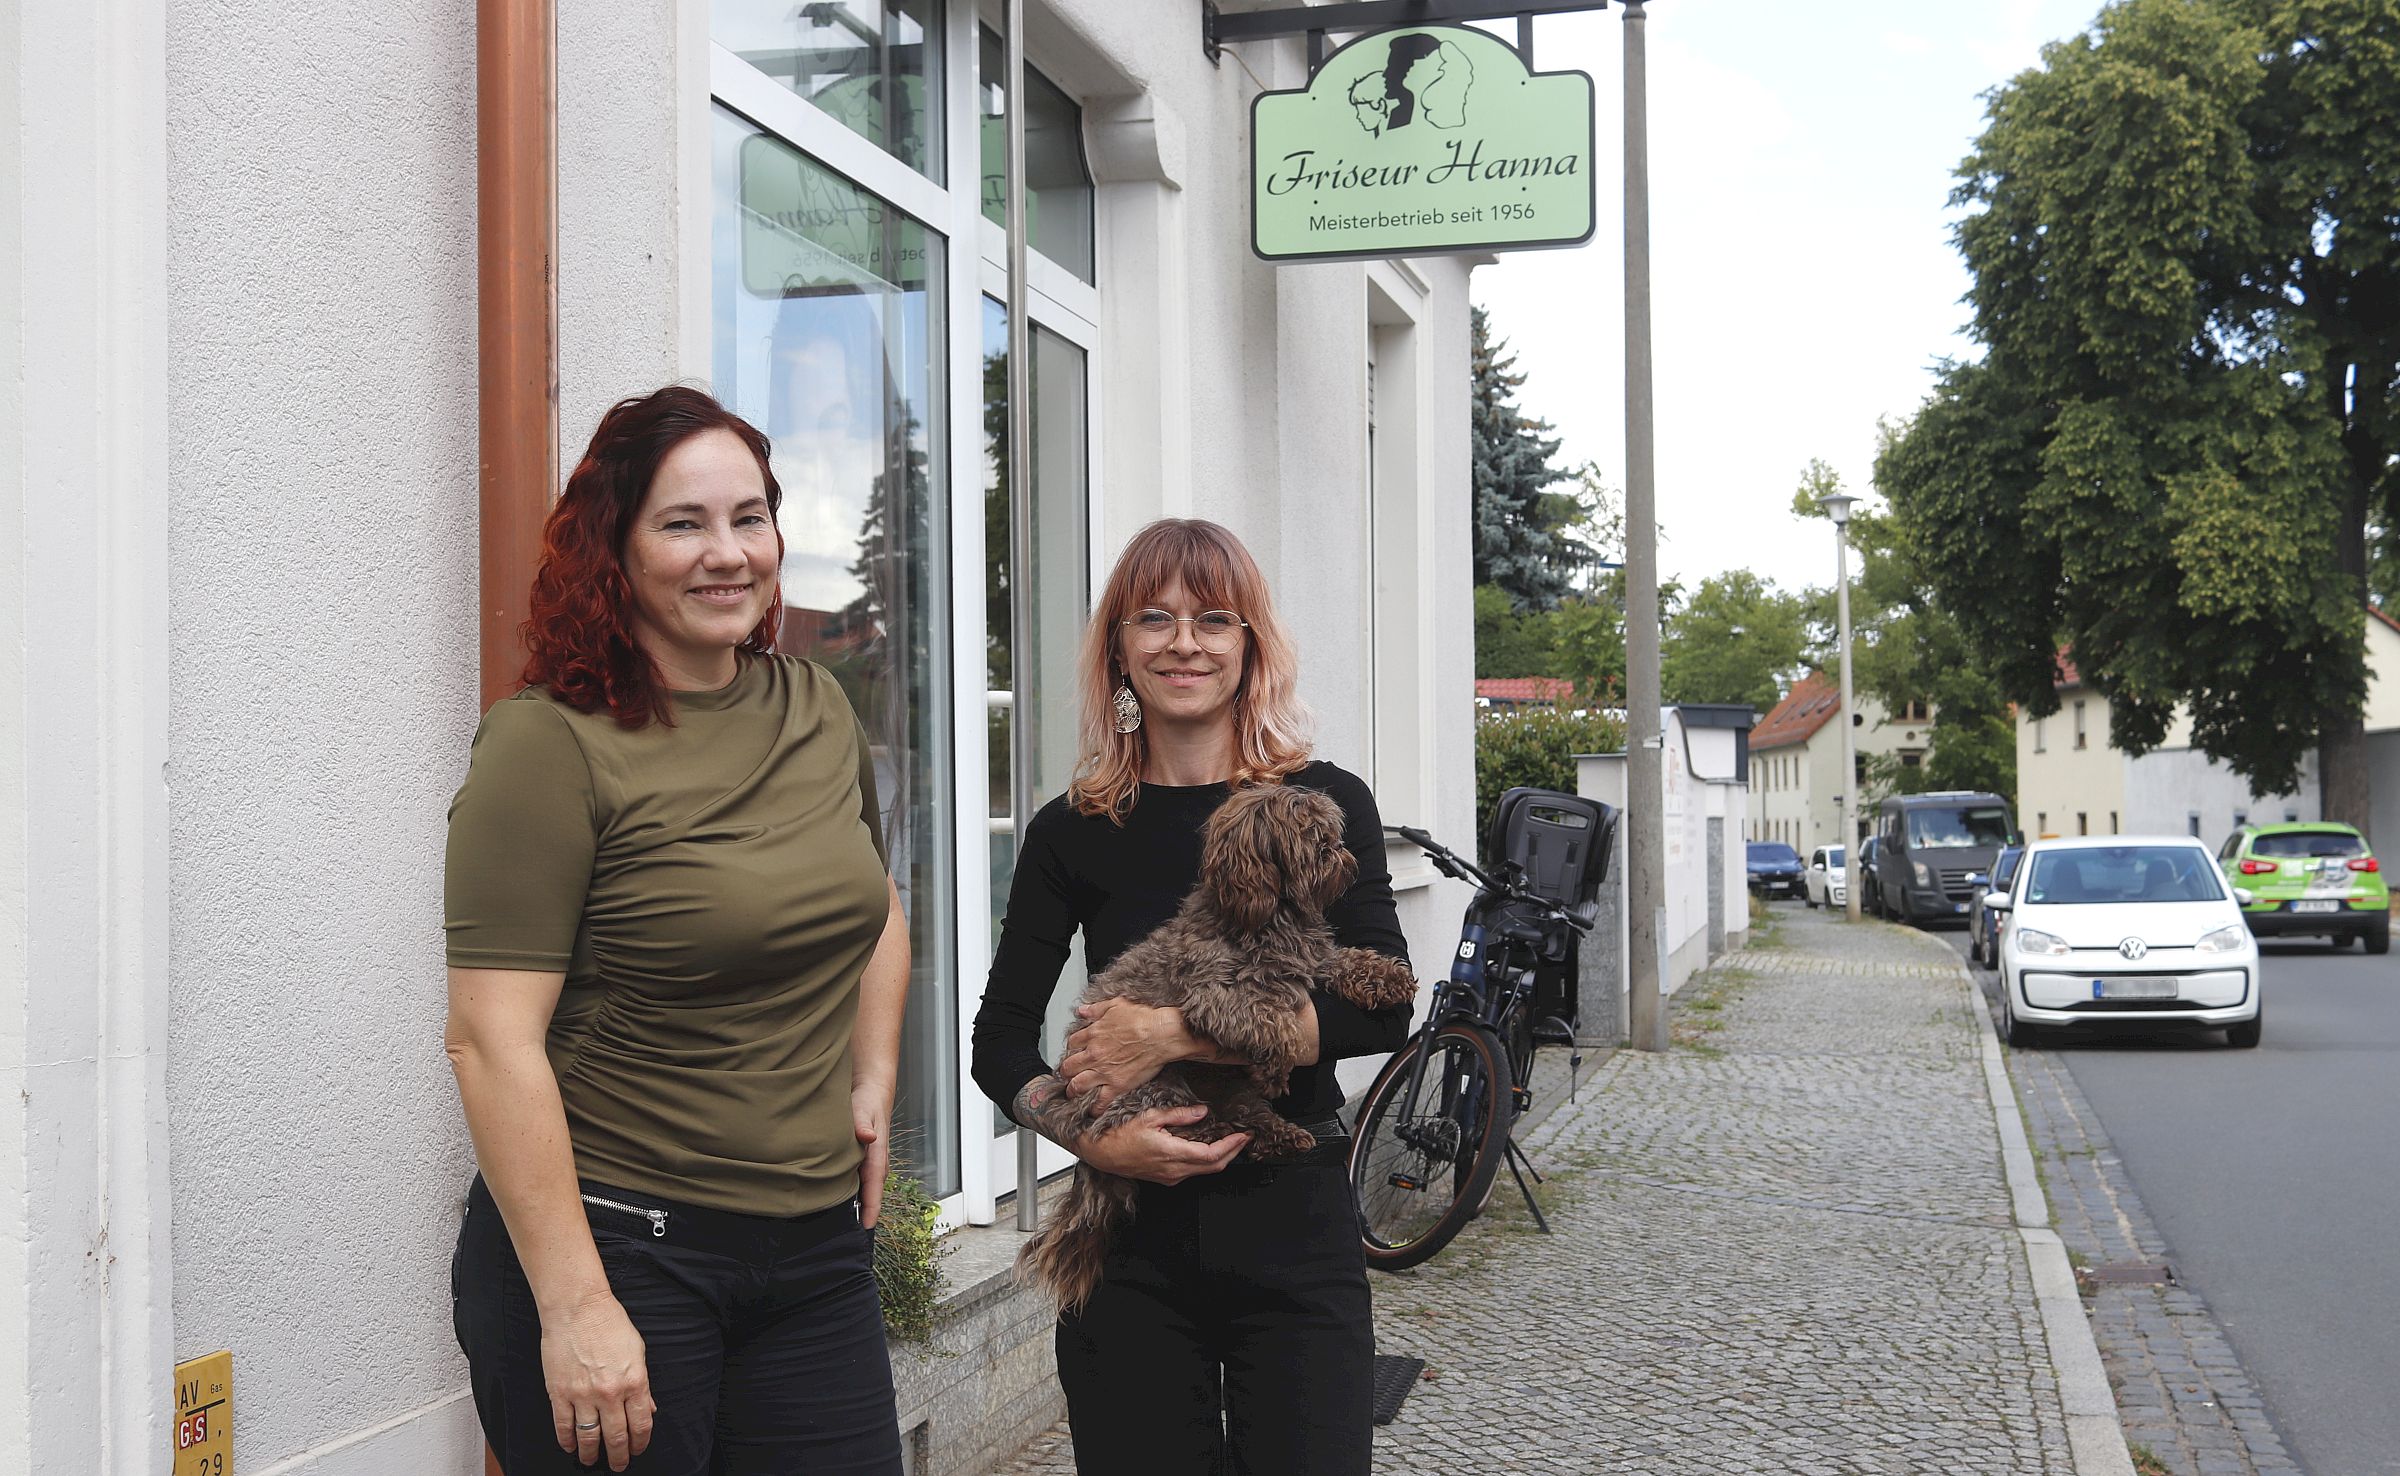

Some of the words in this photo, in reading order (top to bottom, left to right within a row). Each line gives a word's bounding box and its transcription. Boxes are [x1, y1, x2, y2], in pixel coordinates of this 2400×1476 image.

[1266, 150, 1419, 196] Friseur
[1426, 138, 1579, 185] Hanna
[1309, 207, 1445, 232] Meisterbetrieb
[1450, 206, 1483, 225] seit
[1490, 203, 1536, 222] 1956
[210, 1383, 223, 1395] Gas
